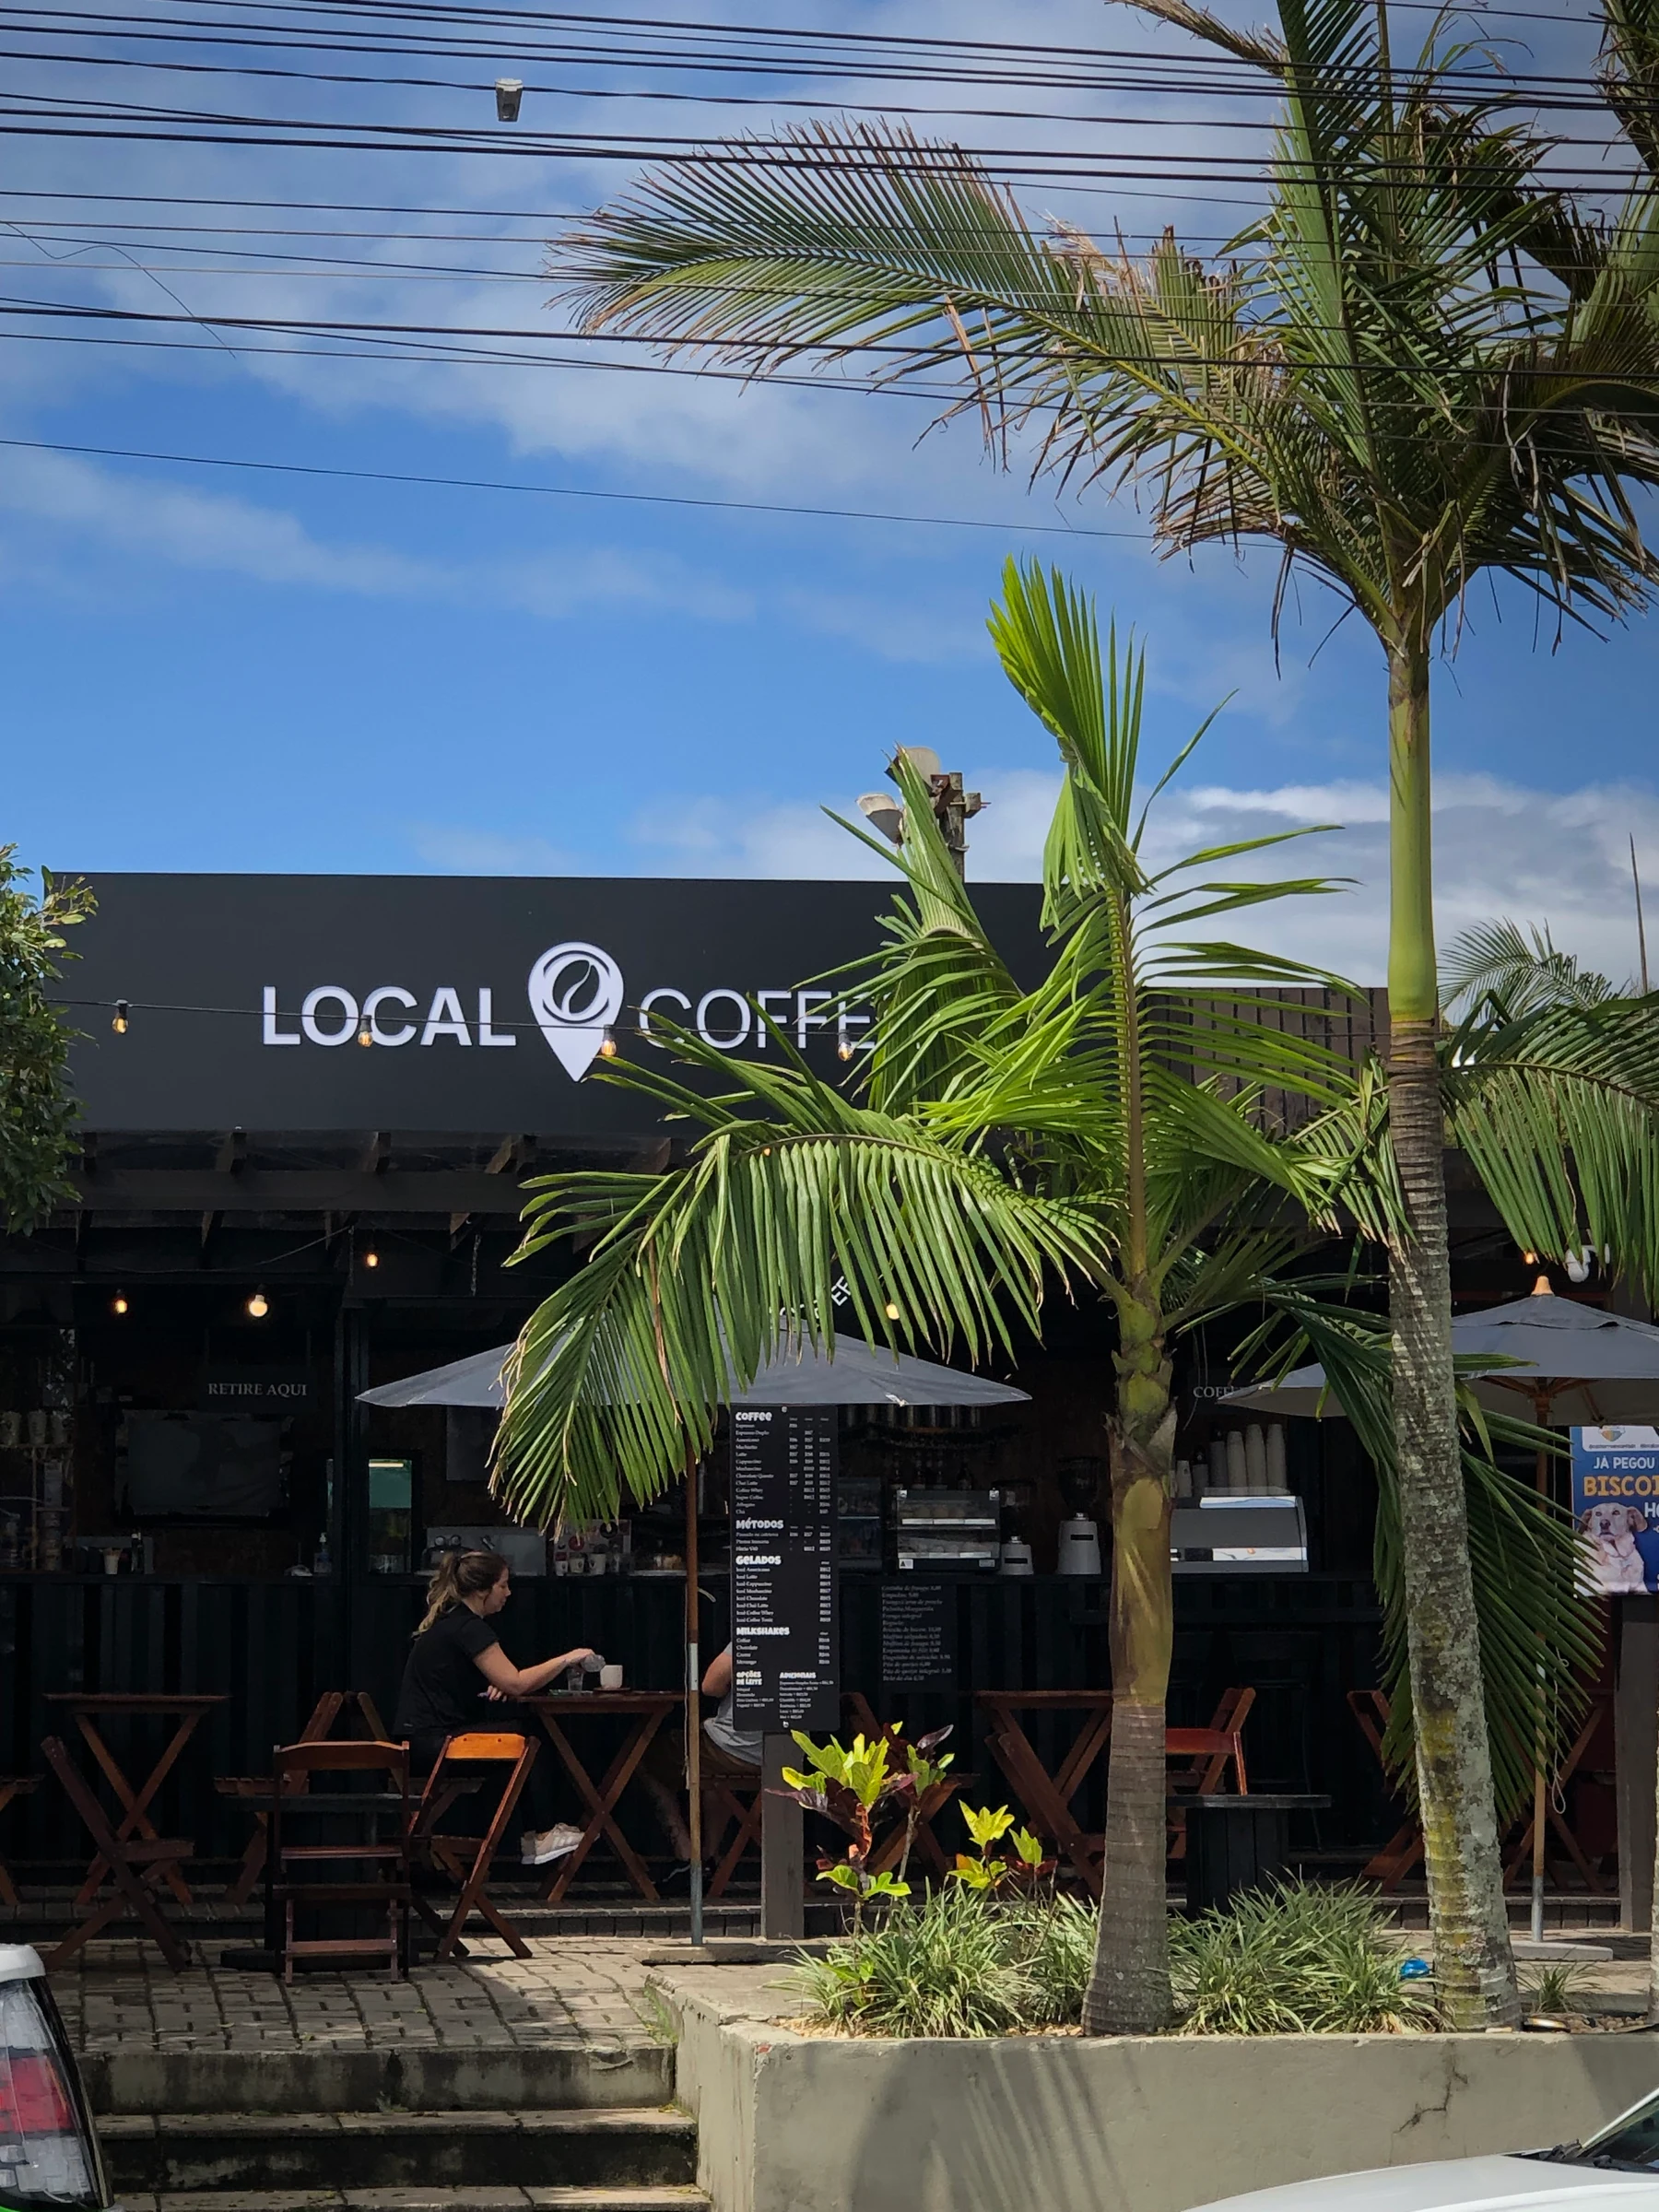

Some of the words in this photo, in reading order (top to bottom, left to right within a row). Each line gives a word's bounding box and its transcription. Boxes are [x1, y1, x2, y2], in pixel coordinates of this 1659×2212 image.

[263, 985, 517, 1047] LOCAL
[638, 987, 920, 1049] COFFE
[207, 1382, 264, 1395] RETIRE
[266, 1383, 308, 1398] AQUI
[1594, 1455, 1609, 1469] JÁ
[1613, 1457, 1655, 1469] PEGOU
